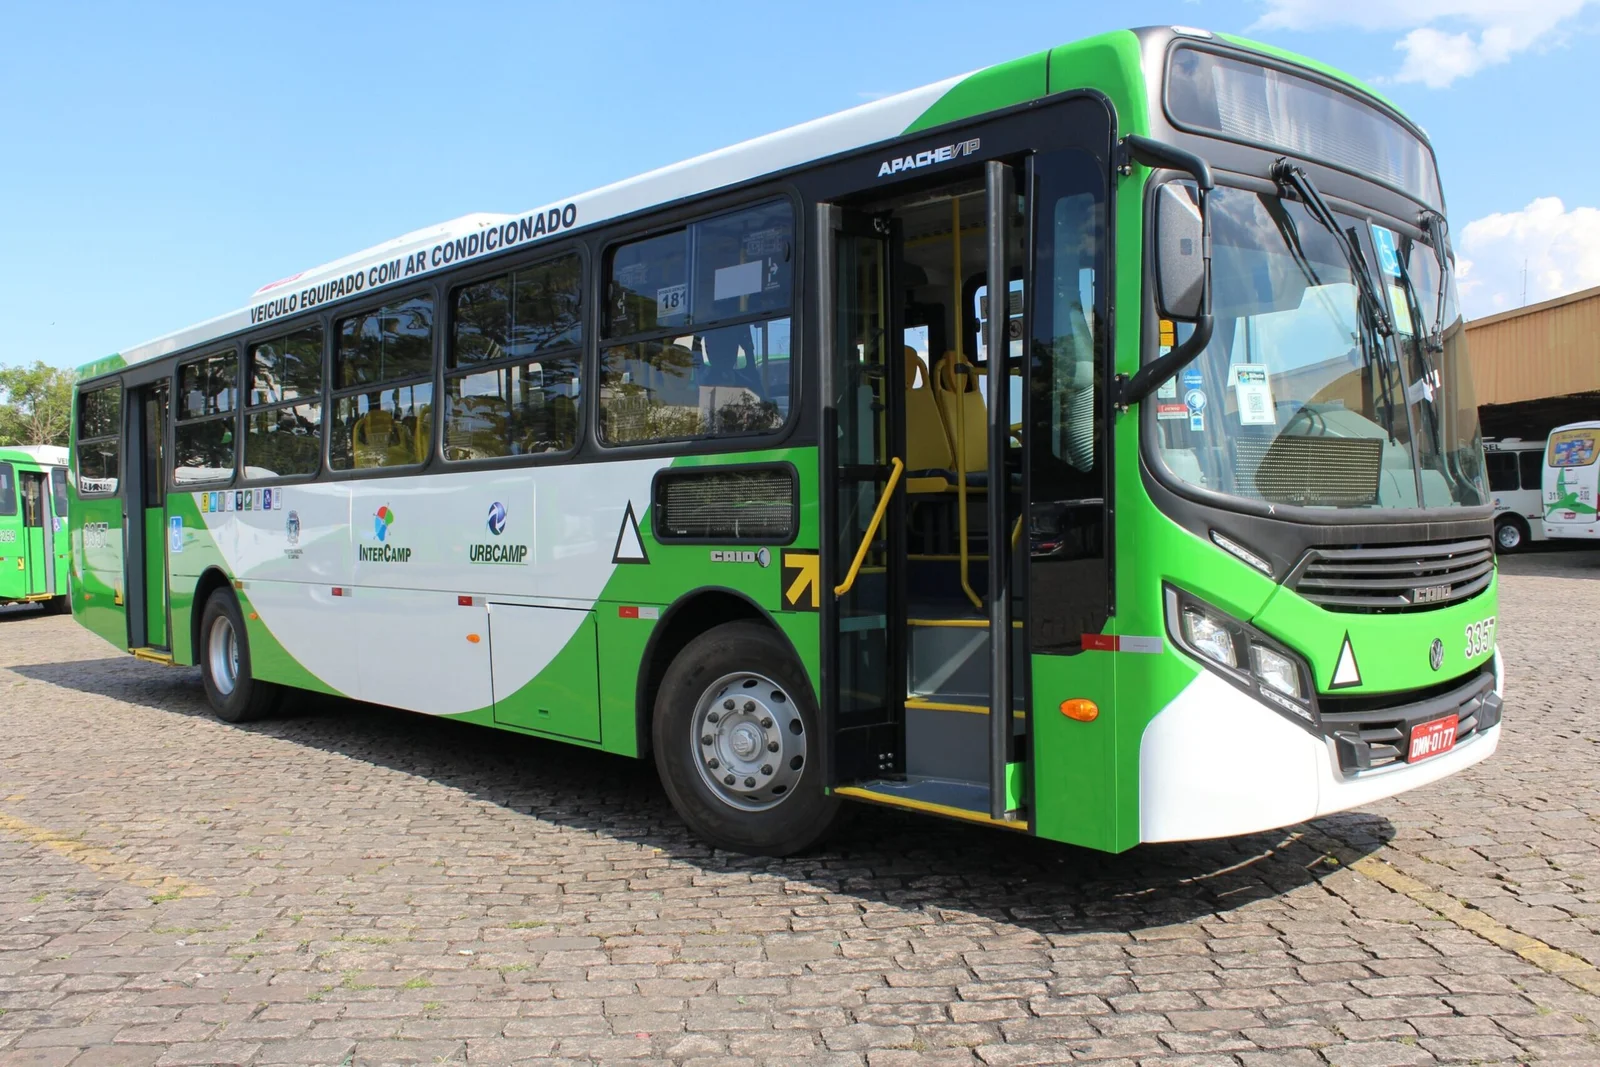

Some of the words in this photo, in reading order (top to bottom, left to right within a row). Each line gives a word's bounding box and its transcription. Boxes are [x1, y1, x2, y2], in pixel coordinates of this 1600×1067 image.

[250, 293, 297, 324] VEICULO
[300, 271, 364, 309] EQUIPADO
[368, 259, 401, 287] COM
[404, 250, 427, 276] AR
[431, 203, 577, 267] CONDICIONADO
[662, 290, 686, 310] 181
[83, 521, 109, 548] 3357
[469, 544, 528, 563] URBCAMP
[710, 550, 756, 563] CAIO
[1413, 584, 1452, 604] CAIO
[1465, 616, 1496, 659] 3357
